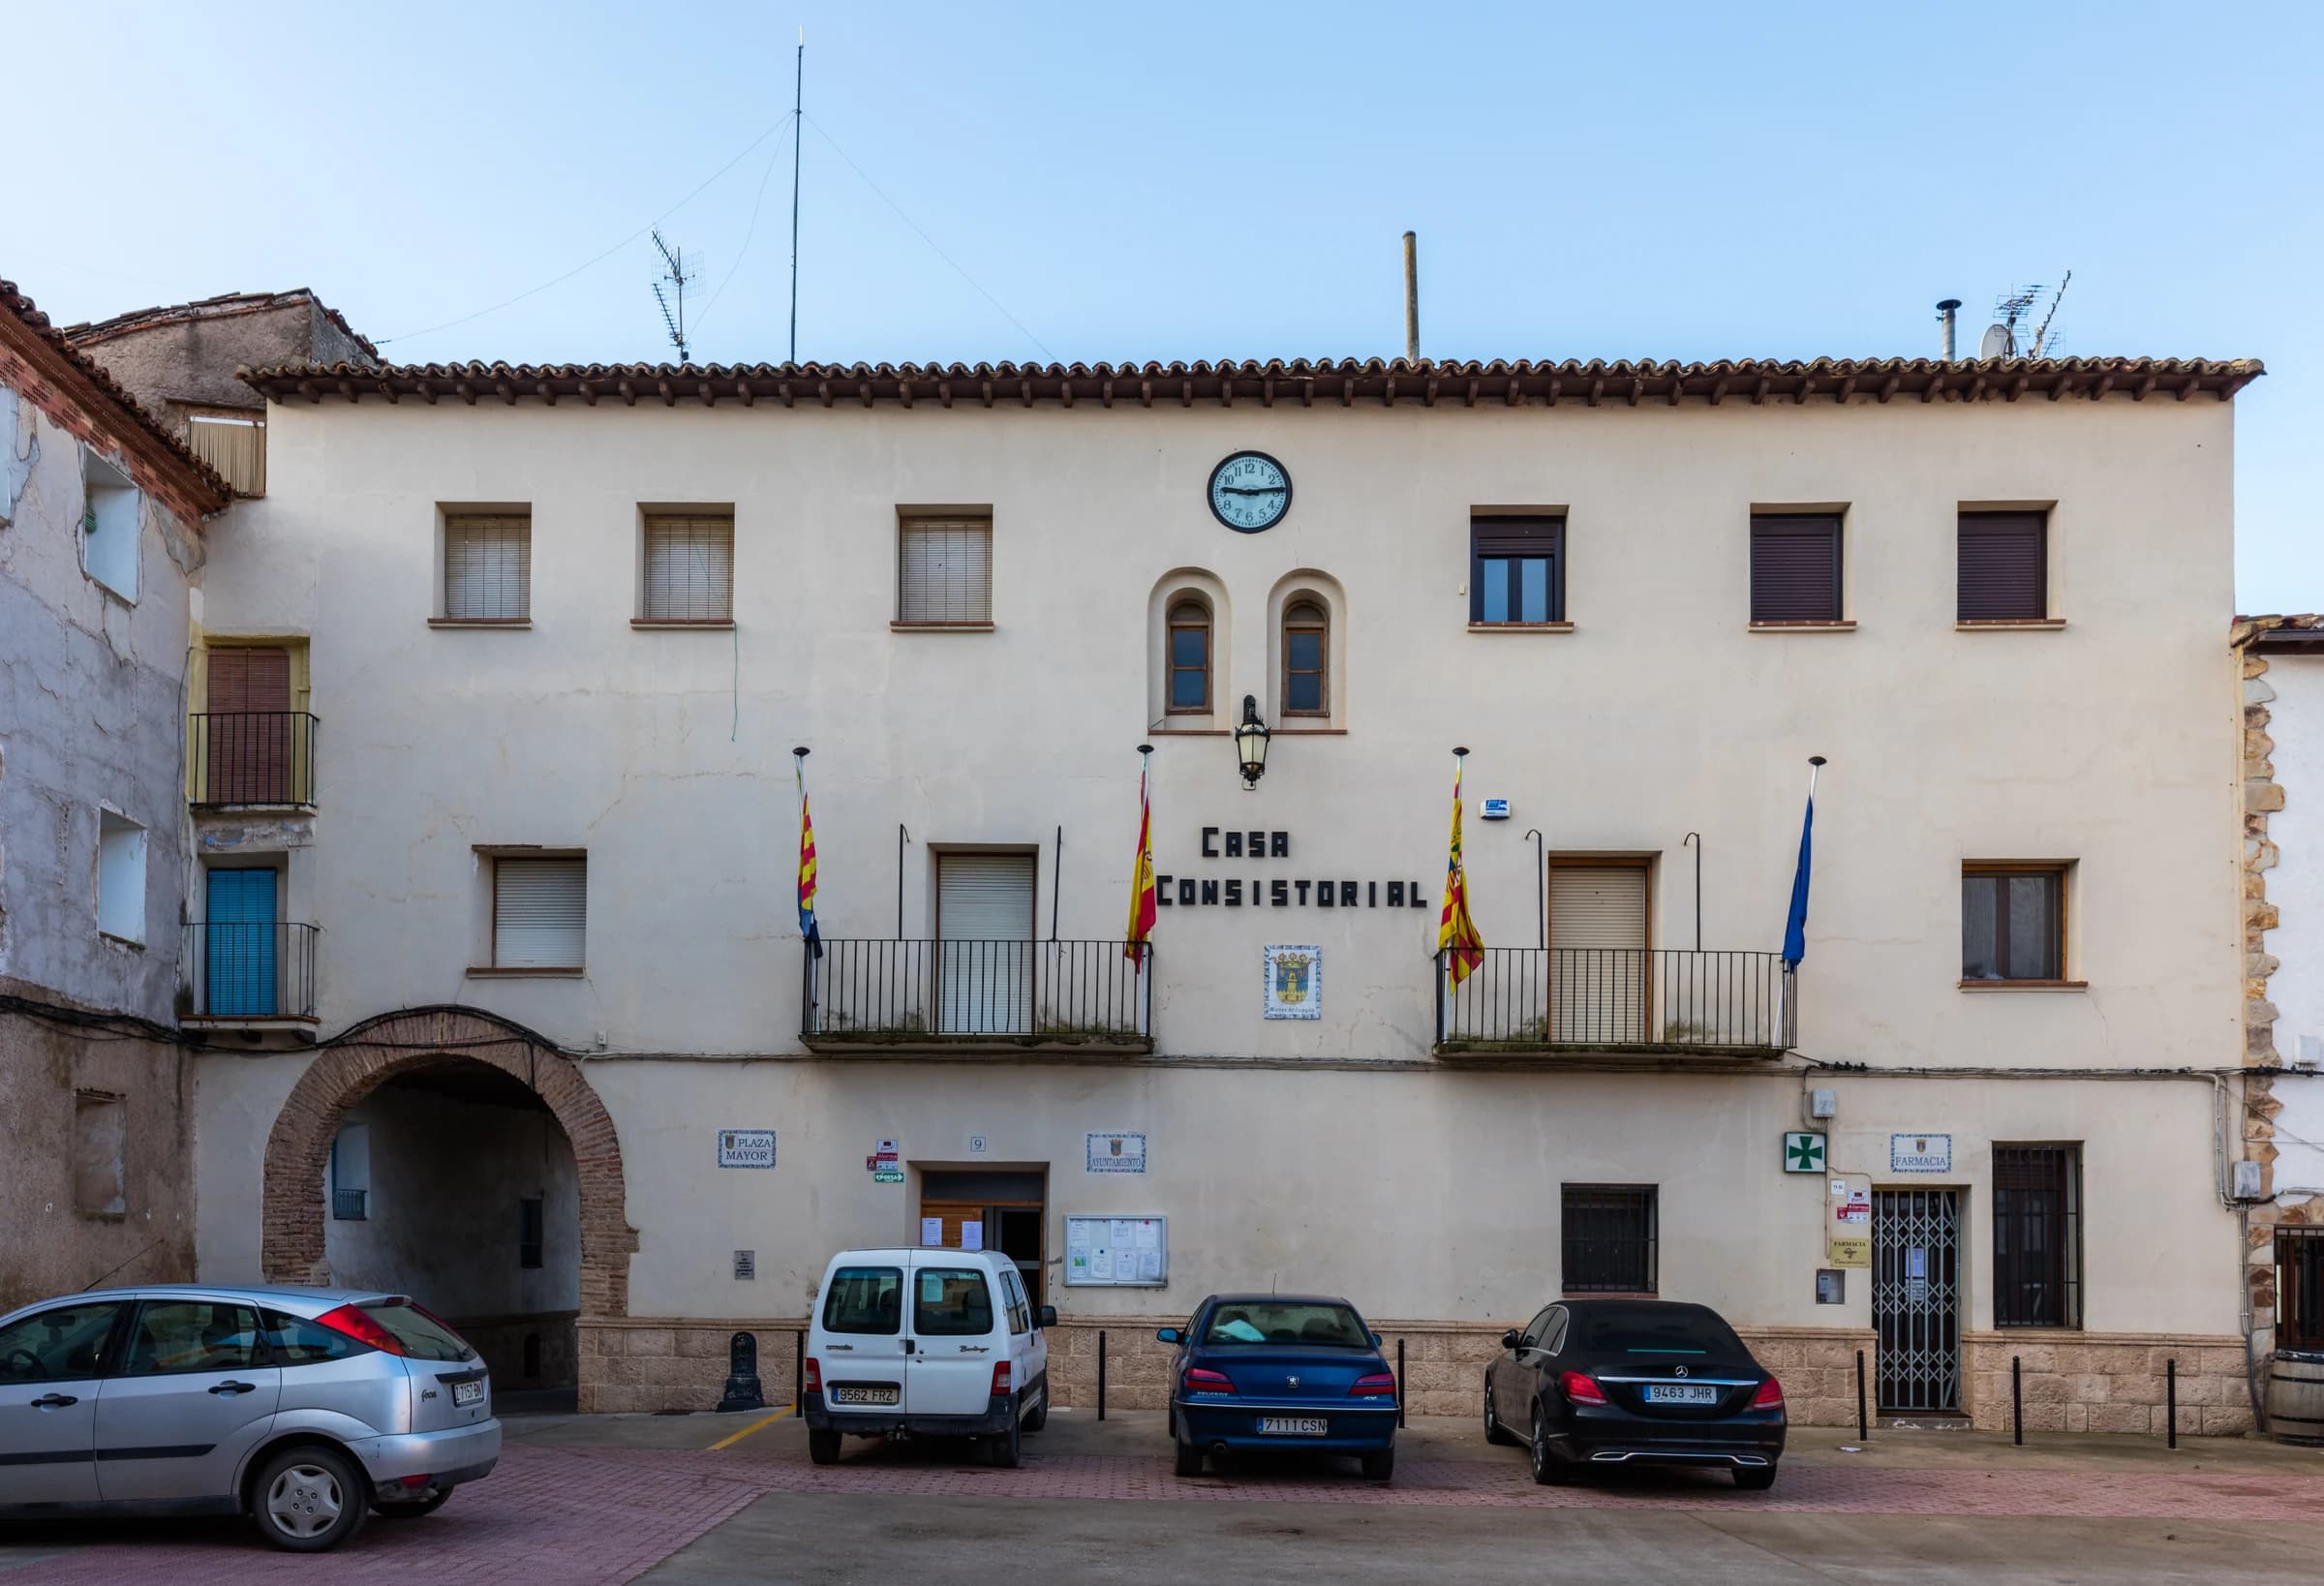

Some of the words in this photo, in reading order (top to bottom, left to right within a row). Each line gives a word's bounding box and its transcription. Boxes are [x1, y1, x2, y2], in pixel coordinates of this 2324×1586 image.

[1235, 466, 1241, 476] 11
[1244, 463, 1255, 473] 12
[1224, 474, 1234, 485] 10
[1269, 474, 1276, 485] 2
[1223, 500, 1232, 510] 8
[1268, 500, 1274, 510] 4
[1235, 508, 1242, 518] 7
[1245, 511, 1253, 522] 6
[1259, 508, 1267, 519] 5
[1202, 827, 1289, 858] CASA
[1156, 875, 1427, 908] CONSISTORIAL
[738, 1138, 772, 1148] PLAZA
[974, 1139, 982, 1150] 9
[726, 1150, 768, 1161] MAYOR
[1092, 1157, 1142, 1168] AYUNTAMIENTO
[1895, 1156, 1946, 1167] FARMACIA
[840, 1389, 868, 1401] 9562
[872, 1389, 893, 1401] FRZ
[1653, 1387, 1685, 1398] 9463
[1690, 1388, 1712, 1399] JHR
[1266, 1418, 1298, 1432] 7111
[1301, 1418, 1327, 1432] CSN
